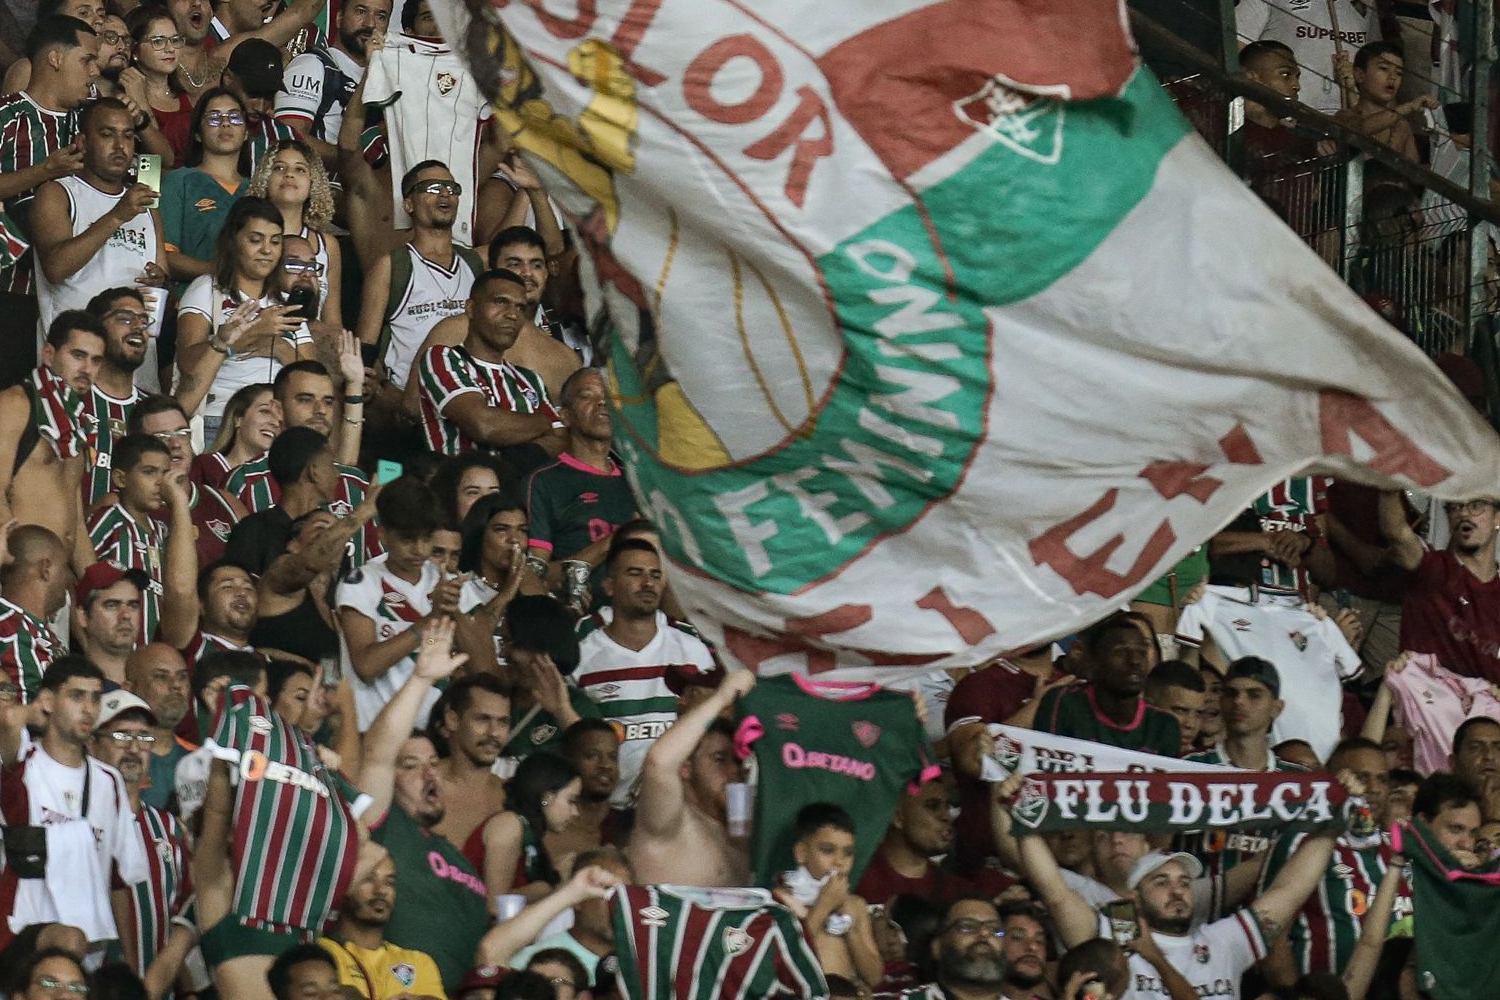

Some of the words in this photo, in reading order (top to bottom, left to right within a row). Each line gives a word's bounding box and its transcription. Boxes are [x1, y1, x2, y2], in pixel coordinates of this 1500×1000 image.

[292, 74, 321, 94] UM
[711, 238, 969, 579] FEMININO
[803, 751, 876, 781] BETANO
[1052, 779, 1151, 821] FLU
[1167, 781, 1334, 826] DELCA
